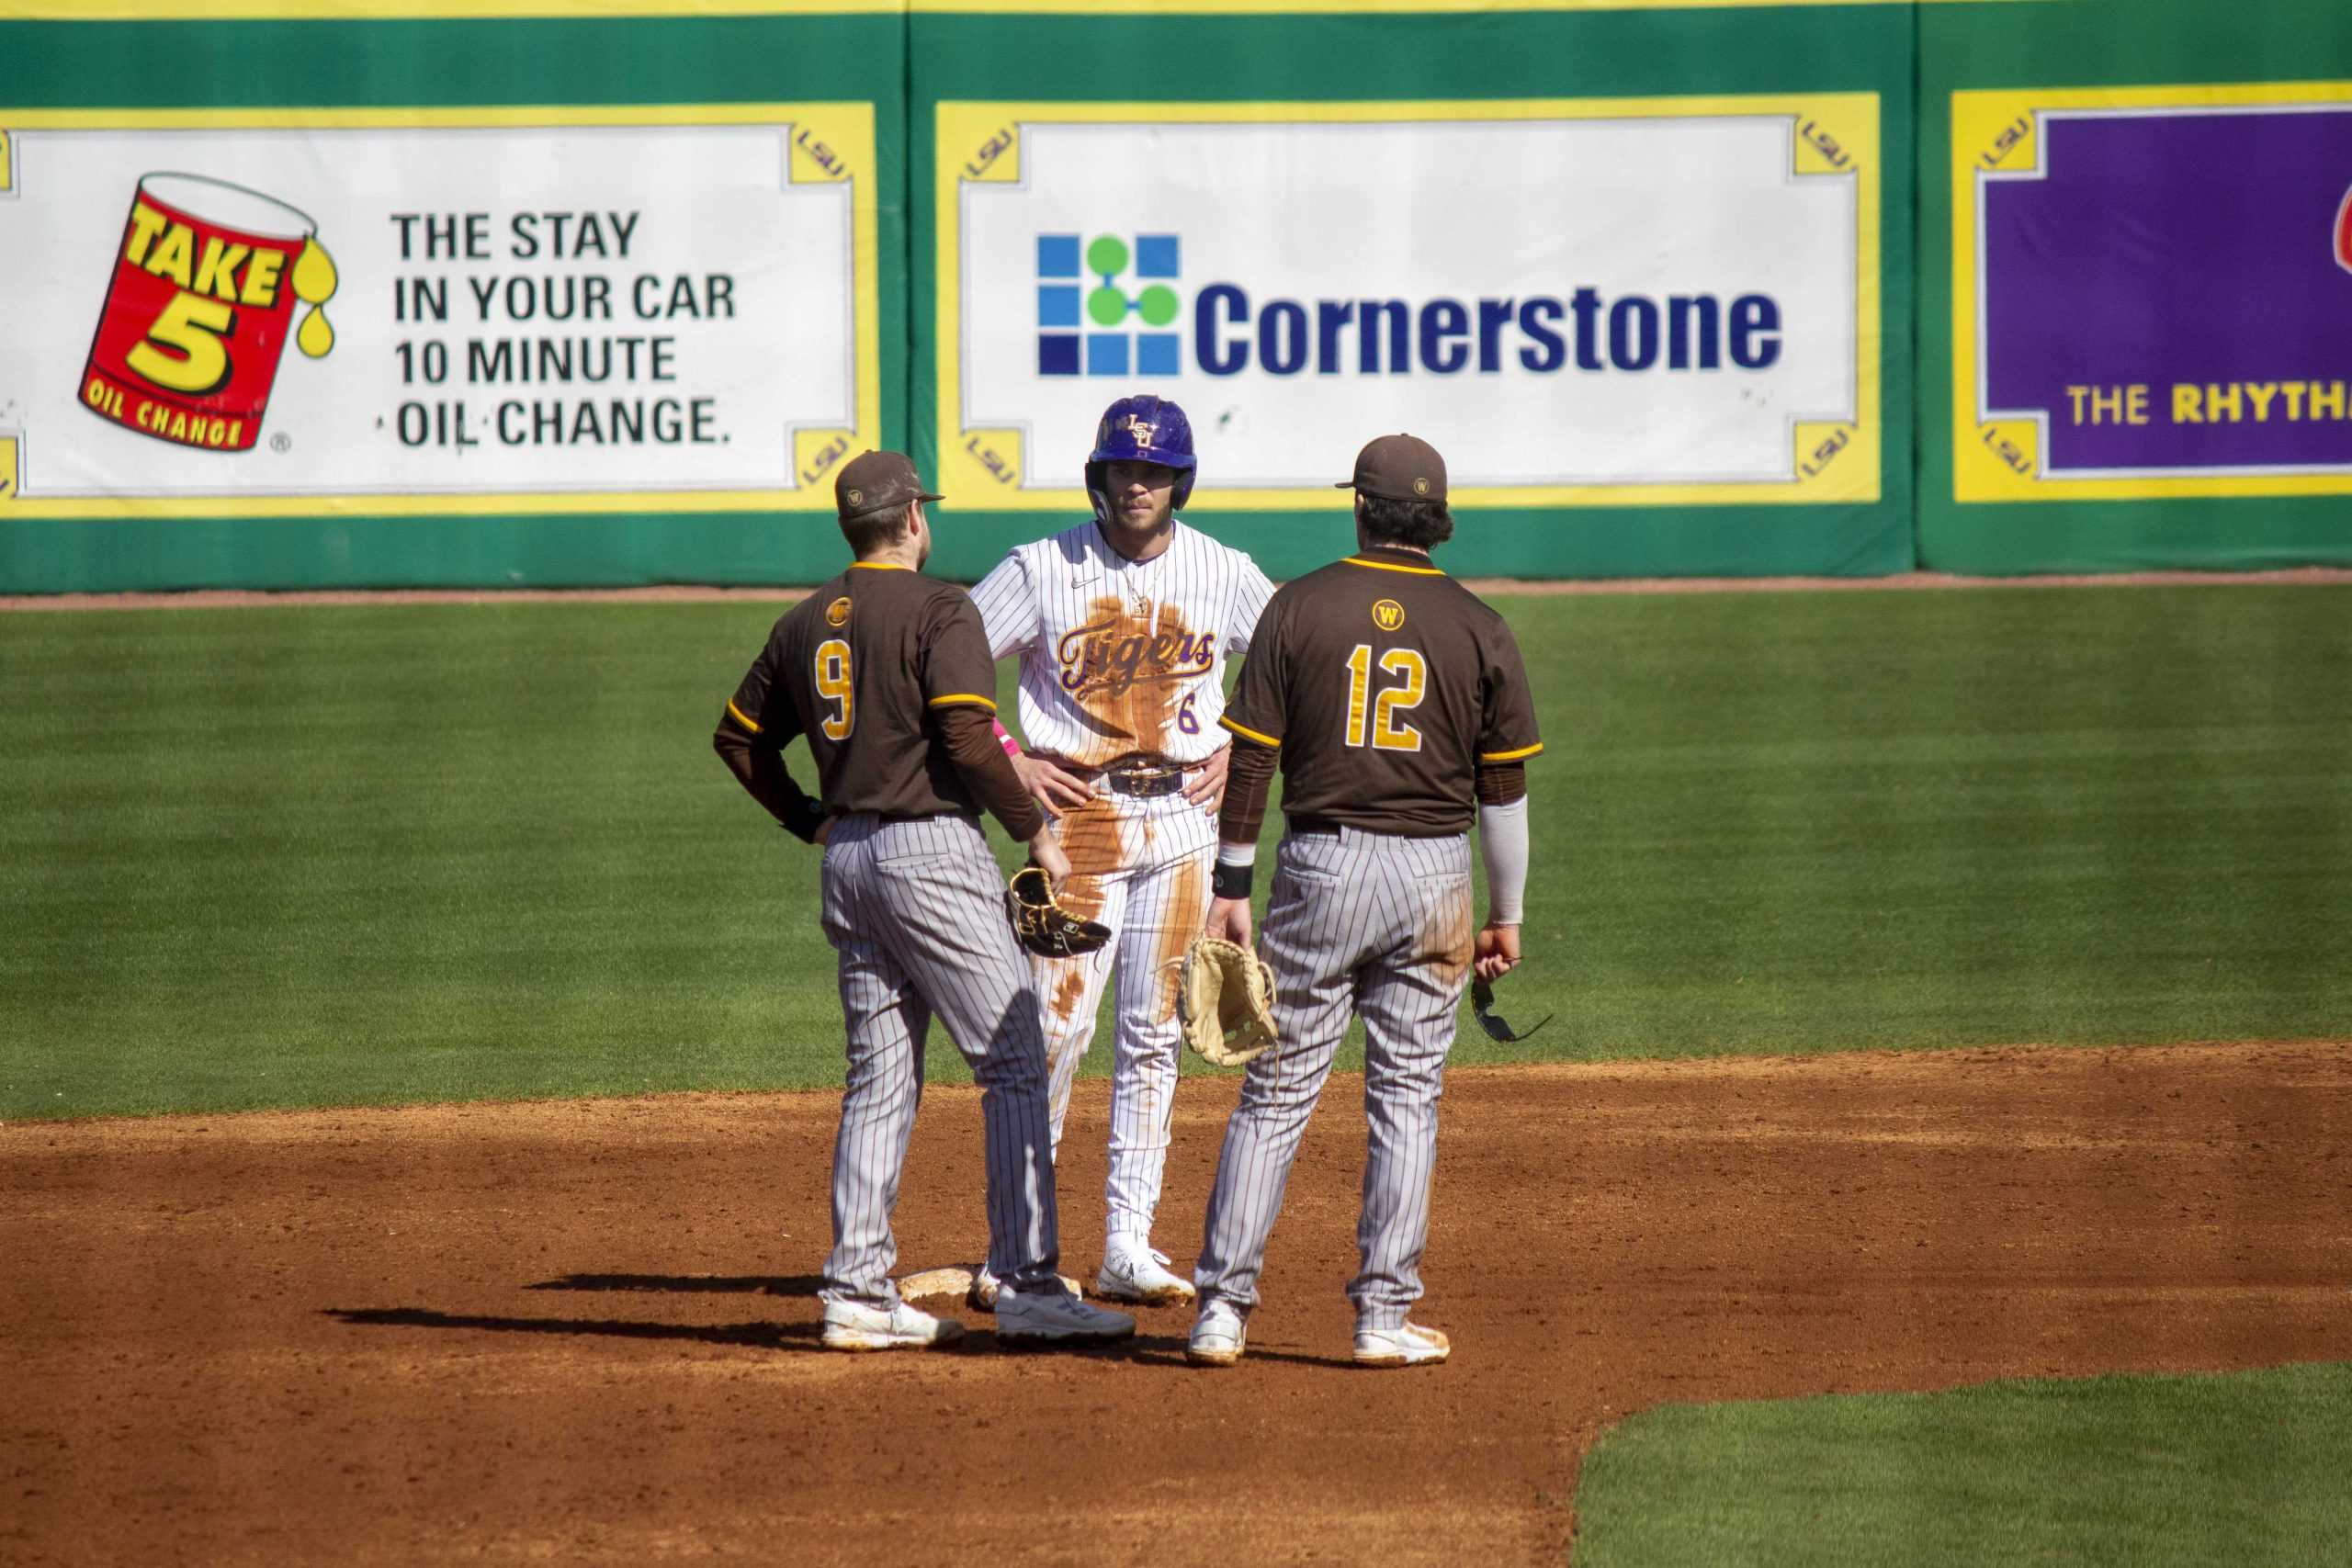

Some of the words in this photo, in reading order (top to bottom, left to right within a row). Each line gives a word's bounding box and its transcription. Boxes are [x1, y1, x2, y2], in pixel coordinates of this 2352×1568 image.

[796, 129, 846, 177] LSU
[965, 130, 1013, 177] LSU
[125, 201, 288, 310] TAKE
[390, 212, 491, 261] THE
[511, 210, 640, 260] STAY
[394, 277, 448, 322] IN
[469, 275, 614, 321] YOUR
[633, 274, 736, 321] CAR
[125, 289, 239, 397] 5
[1194, 281, 1782, 378] Cornerstone
[394, 339, 448, 385] 10
[467, 336, 677, 385] MINUTE
[87, 378, 125, 419] OIL
[136, 400, 244, 448] CHANGE
[397, 400, 479, 448] OIL
[497, 398, 732, 446] CHANGE.
[2065, 384, 2150, 426] THE
[2171, 380, 2352, 423] RHYTH
[1127, 413, 1154, 449] LSU
[802, 435, 849, 485] LSU
[965, 435, 1015, 485] LSU
[1058, 617, 1217, 698] Tigers
[814, 638, 855, 741] 9
[1176, 691, 1201, 735] 6
[1345, 644, 1428, 752] 12
